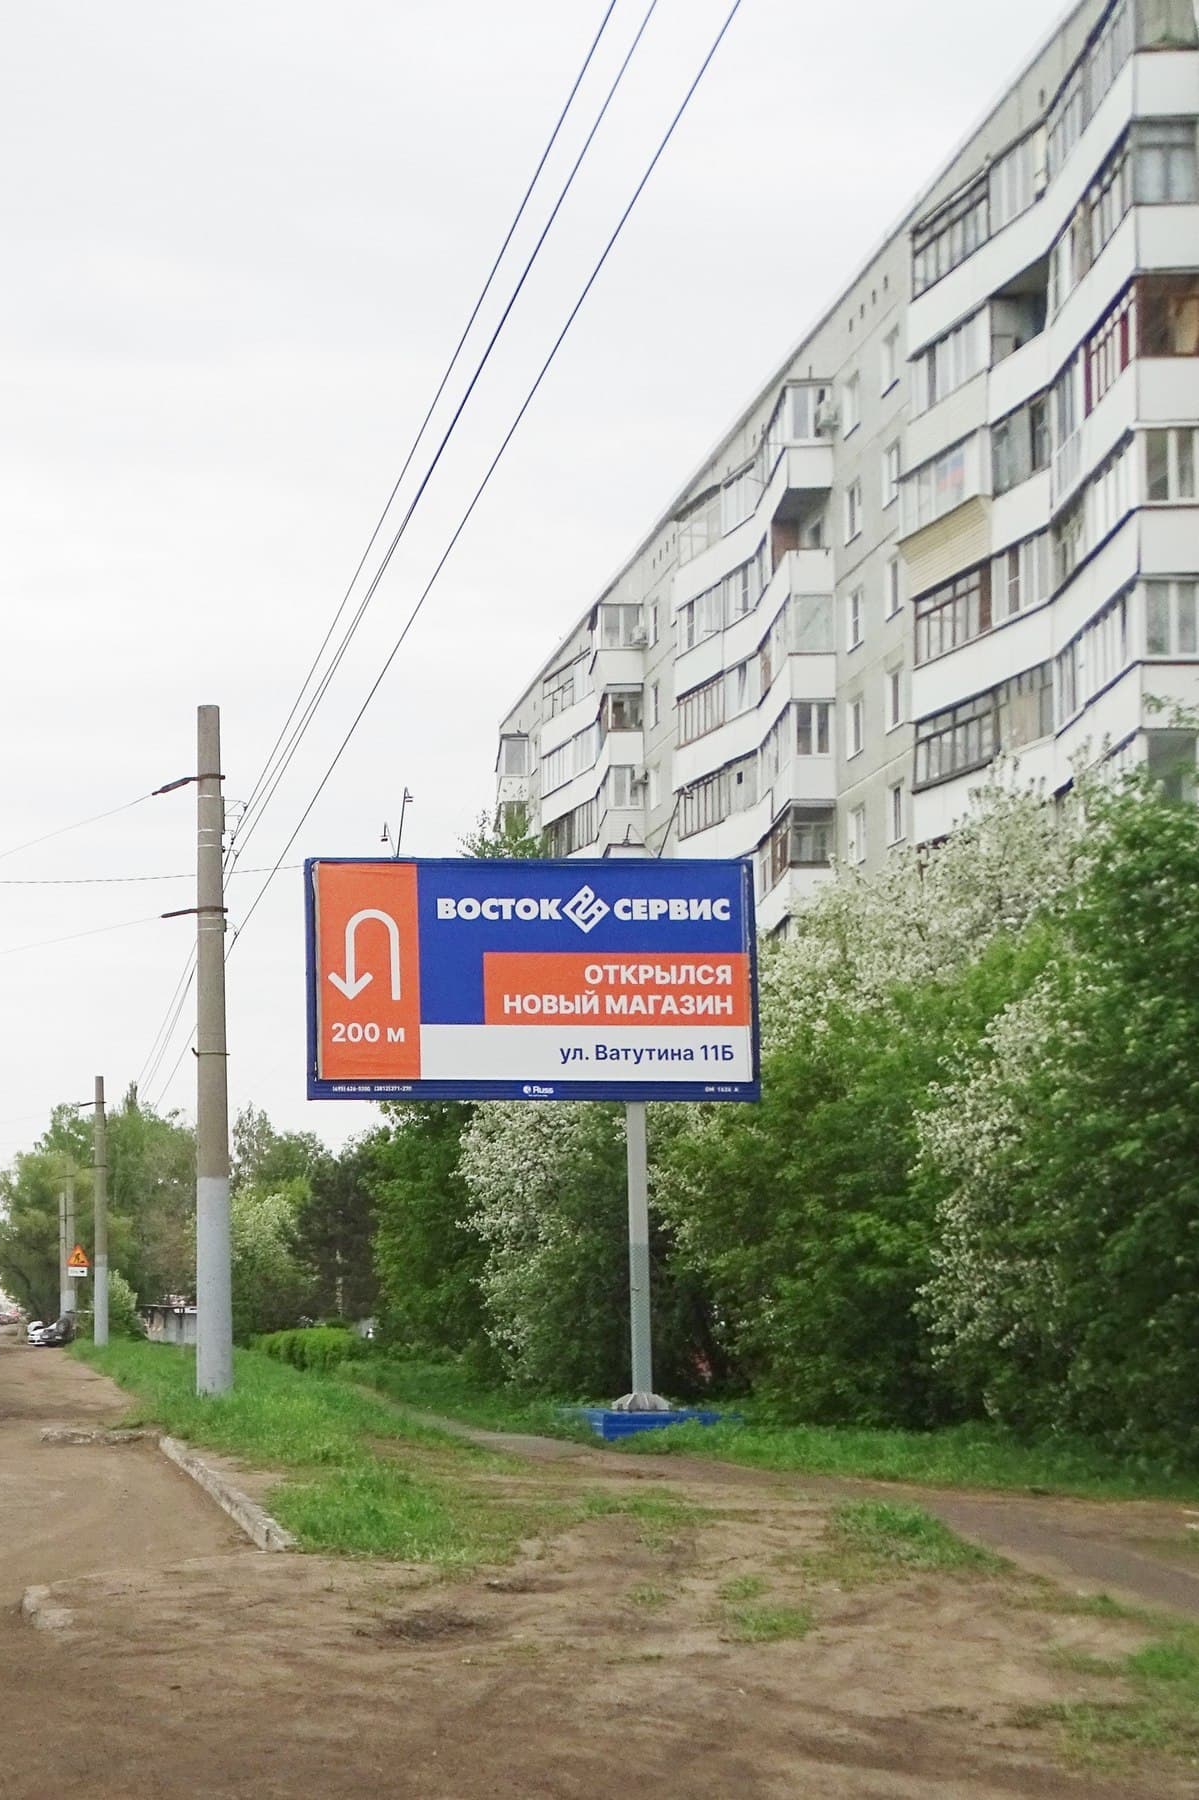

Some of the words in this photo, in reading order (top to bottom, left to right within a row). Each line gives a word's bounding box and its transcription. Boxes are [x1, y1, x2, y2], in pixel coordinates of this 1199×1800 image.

[436, 897, 563, 921] ВОСТОК
[613, 898, 731, 921] СЕРВИС
[584, 964, 733, 986] ОТКРЫЛСЯ
[503, 990, 600, 1015] НОВЫЙ
[605, 994, 734, 1016] МАГАЗИН
[331, 1022, 381, 1043] 200
[559, 1046, 590, 1065] ул.
[595, 1044, 695, 1065] Ватутина
[699, 1044, 735, 1062] 11Б
